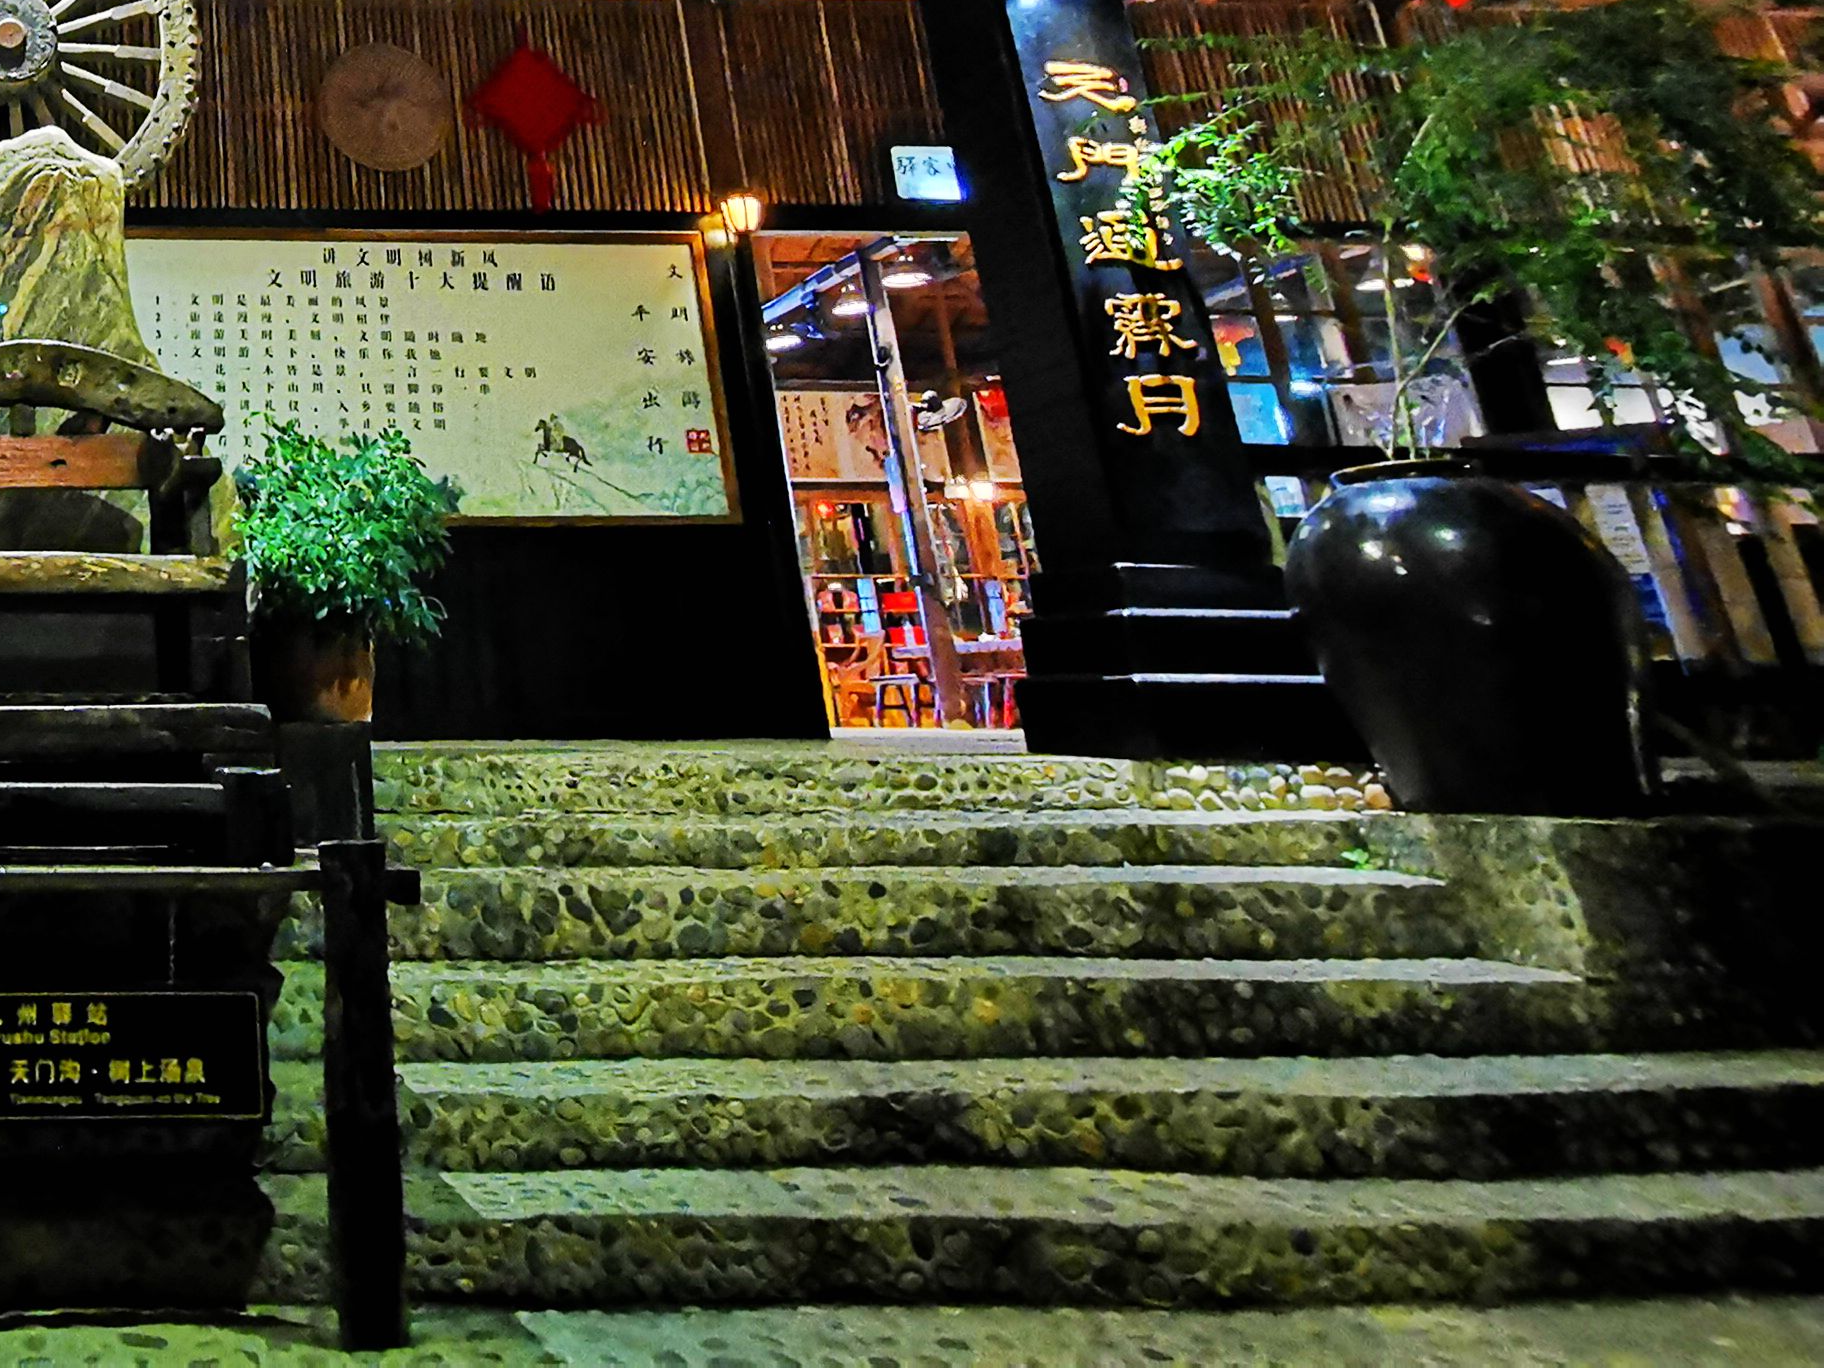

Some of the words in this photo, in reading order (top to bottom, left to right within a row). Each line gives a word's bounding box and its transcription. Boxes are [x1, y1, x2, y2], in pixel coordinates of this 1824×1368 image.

[322, 247, 499, 268] 讲文明树新风
[267, 268, 556, 292] 文明旅游十大提醒语
